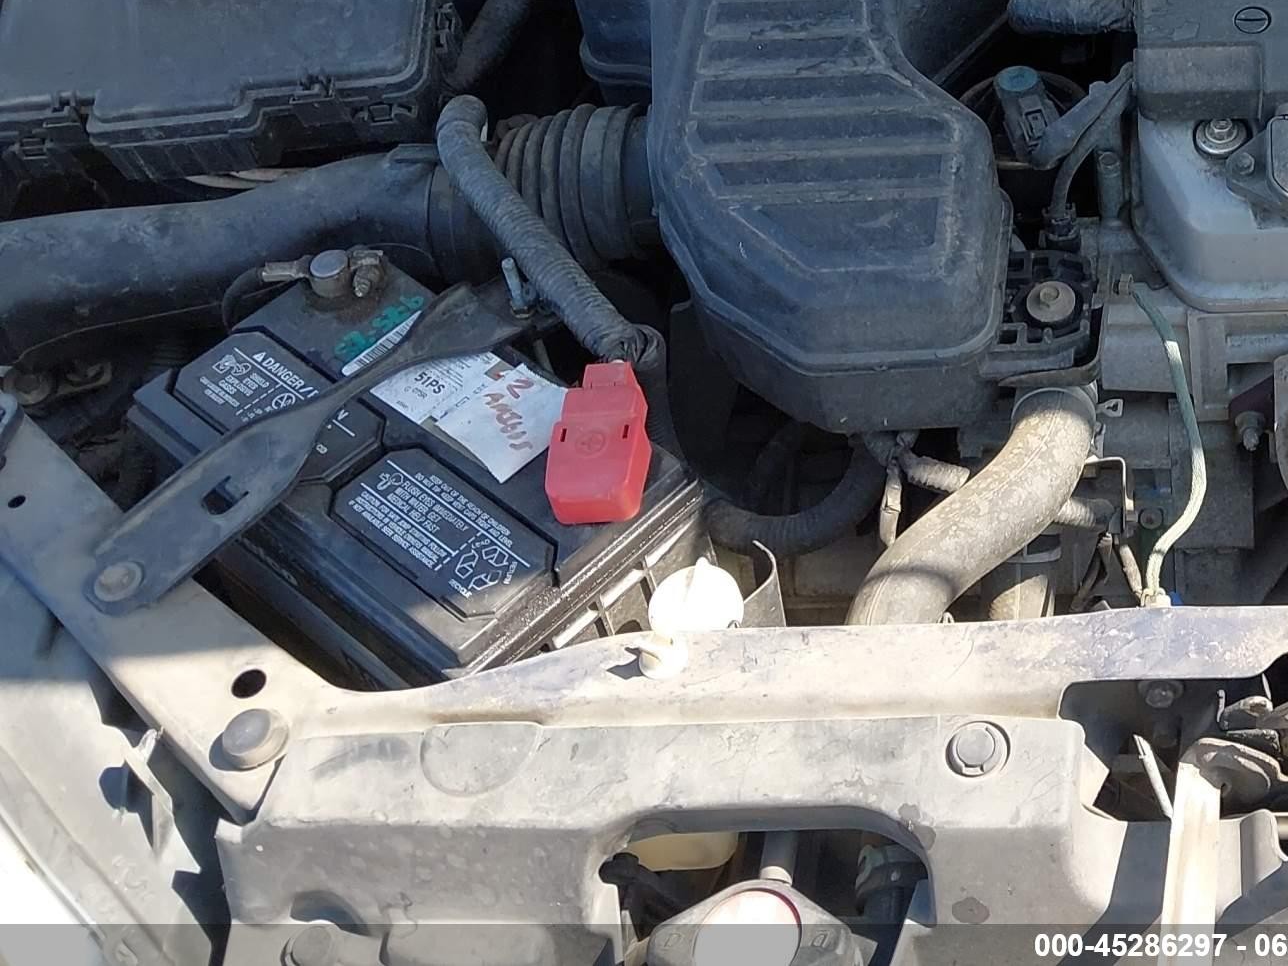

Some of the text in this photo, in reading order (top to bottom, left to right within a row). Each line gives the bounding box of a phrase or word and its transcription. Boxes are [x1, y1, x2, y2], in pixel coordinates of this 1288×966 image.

[225, 376, 253, 396] EXPLOSIVE
[243, 379, 258, 389] EYES
[414, 371, 445, 395] 51PS
[506, 377, 535, 399] 2
[441, 484, 451, 492] OUT
[387, 493, 440, 533] MEDICAL HELP FAST
[395, 488, 412, 500] WITH
[427, 512, 441, 522] GET
[402, 482, 469, 532] FLUSH EYES IMMEDIATELY
